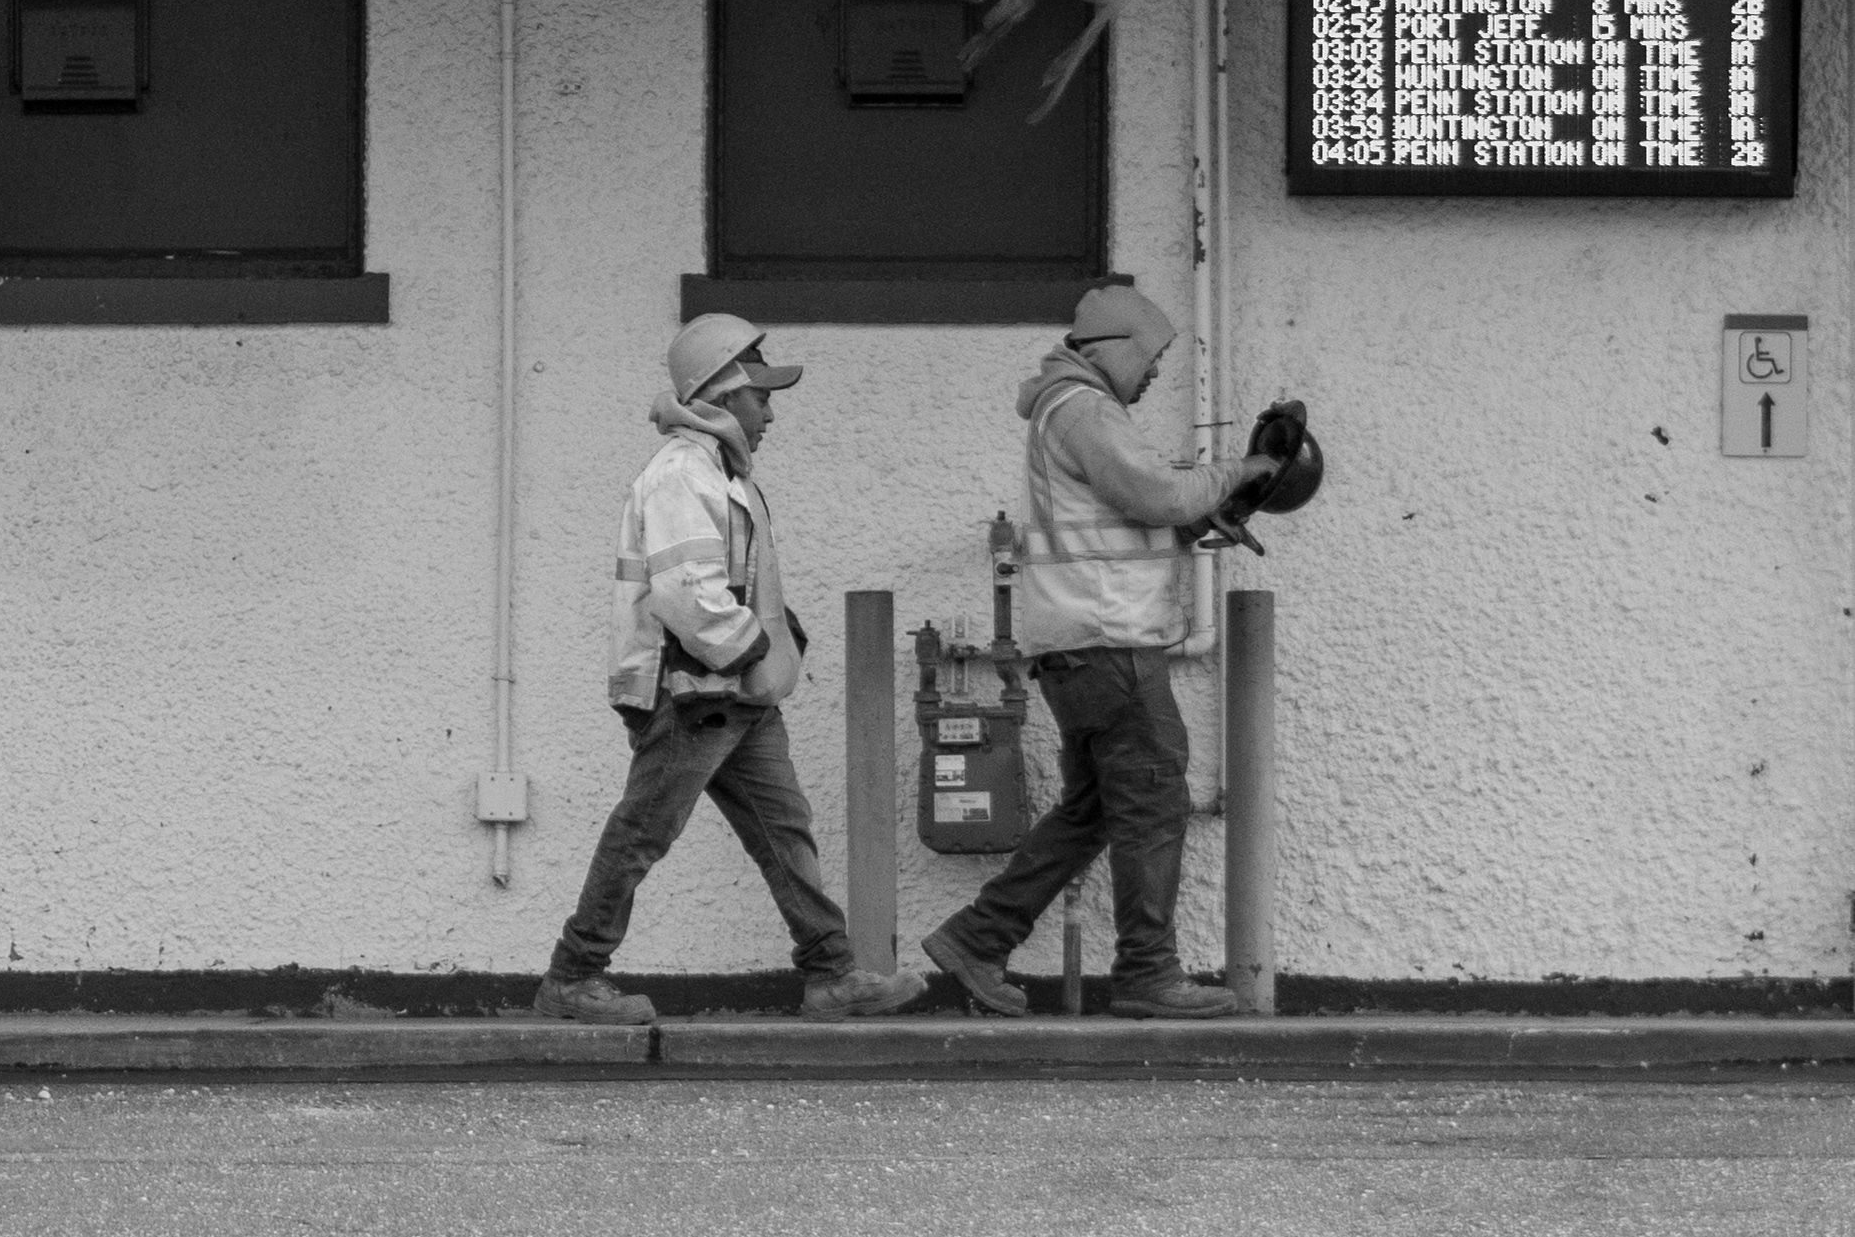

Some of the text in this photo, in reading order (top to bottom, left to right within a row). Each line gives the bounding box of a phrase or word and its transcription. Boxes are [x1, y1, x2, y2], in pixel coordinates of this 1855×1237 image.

[1312, 15, 1385, 39] 02:52
[1394, 15, 1463, 39] PORT
[1477, 15, 1549, 39] JEFF.
[1629, 15, 1691, 39] MINS
[1730, 15, 1766, 39] 2B
[1311, 40, 1385, 64] 03:03
[1394, 40, 1461, 64] PENN
[1473, 40, 1586, 64] STATION
[1591, 40, 1627, 64] ON
[1638, 40, 1703, 64] TIME
[1312, 65, 1385, 88] 03:26
[1394, 65, 1554, 89] HUNTINGTON
[1591, 65, 1627, 89] ON
[1639, 65, 1703, 89] TIME
[1312, 90, 1388, 114] 03:34
[1394, 90, 1461, 114] PENN
[1473, 90, 1586, 114] STATION
[1591, 90, 1627, 114] ON
[1639, 90, 1703, 114] TIME
[1311, 115, 1386, 140] 03:59
[1391, 115, 1554, 140] HUNTINGTON
[1591, 115, 1627, 140] ON
[1639, 115, 1700, 140] TIME
[1311, 141, 1767, 166] 04:05 PENN STATION ON TIME 2B
